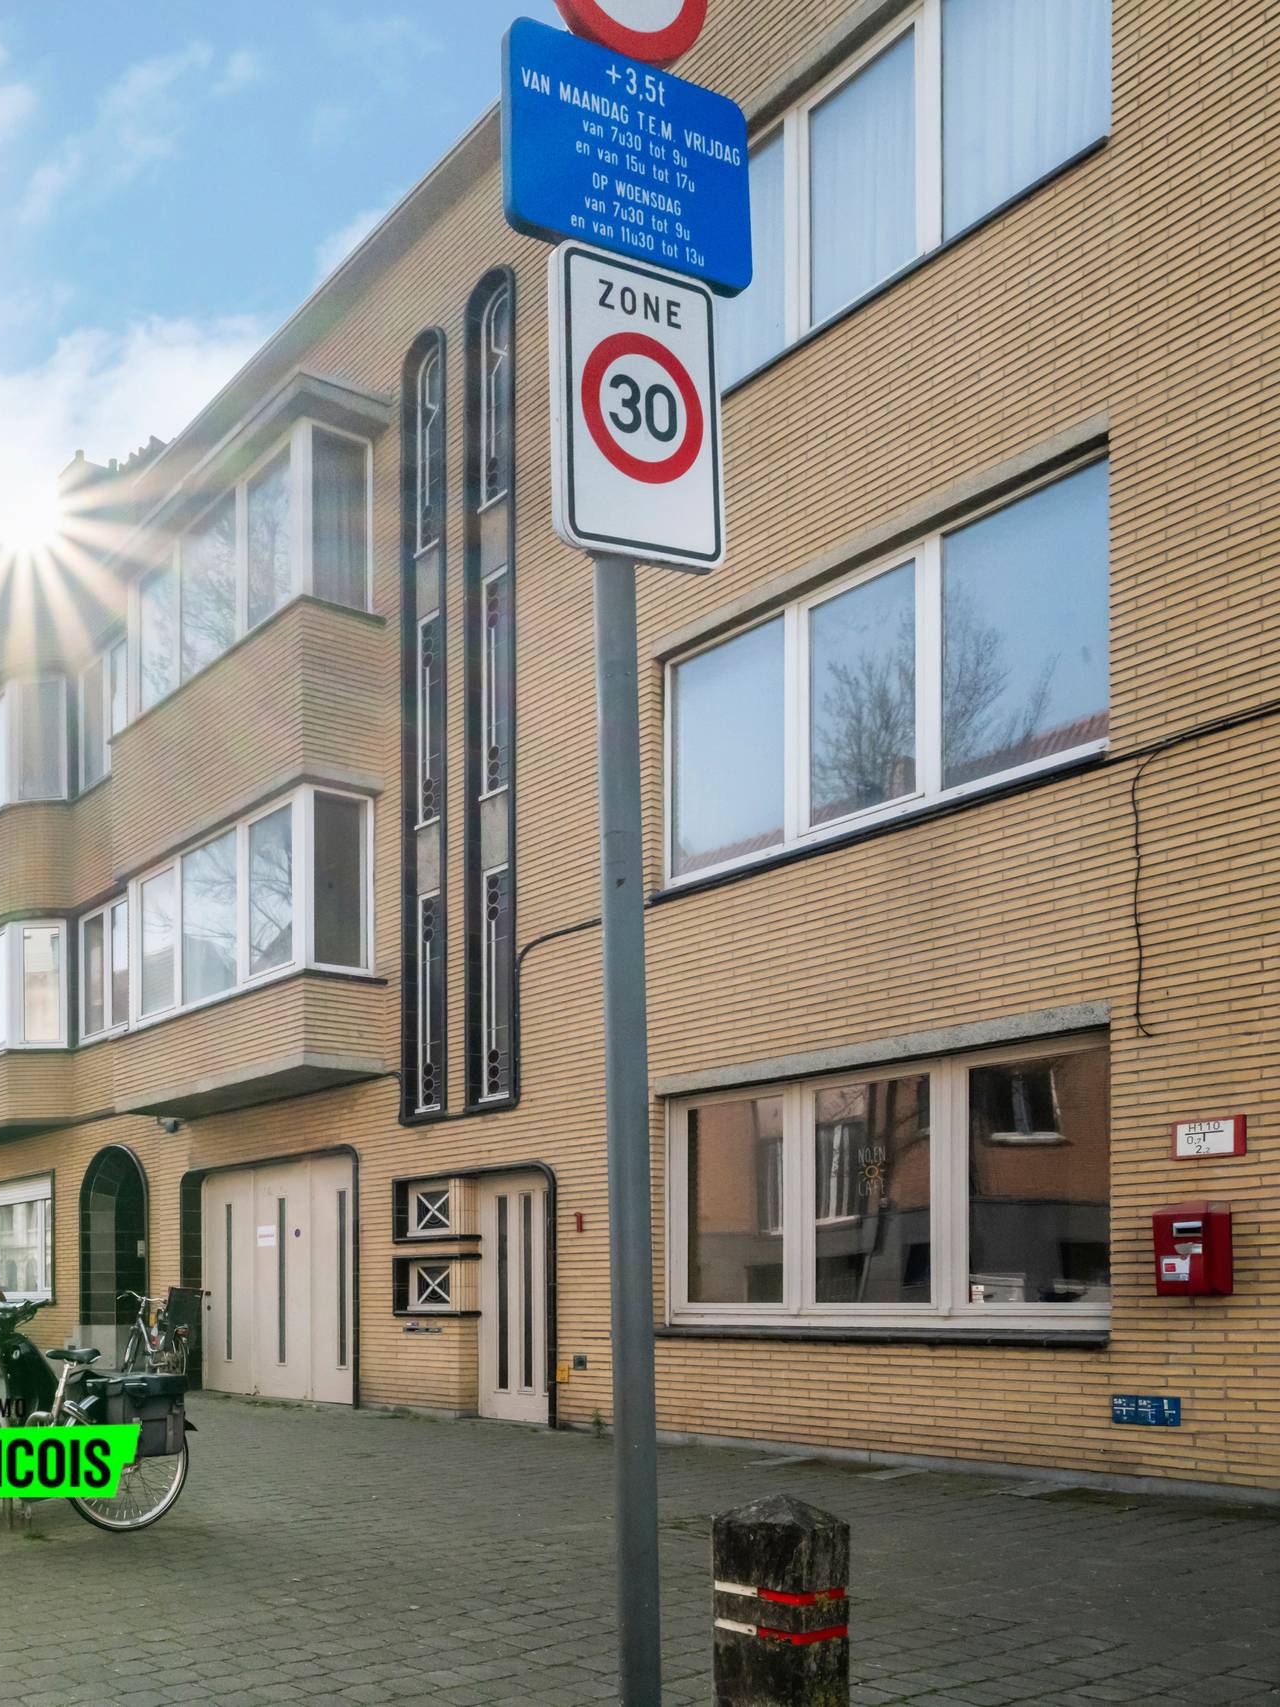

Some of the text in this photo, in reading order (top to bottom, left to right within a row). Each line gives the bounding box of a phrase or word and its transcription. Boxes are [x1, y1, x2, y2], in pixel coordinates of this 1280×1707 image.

[521, 67, 550, 96] VAN
[559, 81, 629, 124] MAANDAG
[684, 129, 741, 167] VRIJDAG
[575, 139, 695, 193] en van 15u tot 17u
[582, 120, 688, 168] van 7u30 tot 9u
[584, 196, 690, 242] van 7u30 tot 9u
[592, 172, 682, 217] OP WOENSDAG
[571, 213, 705, 268] en van 11u30 tot 13u
[598, 278, 682, 330] ZONE
[608, 373, 677, 442] 30
